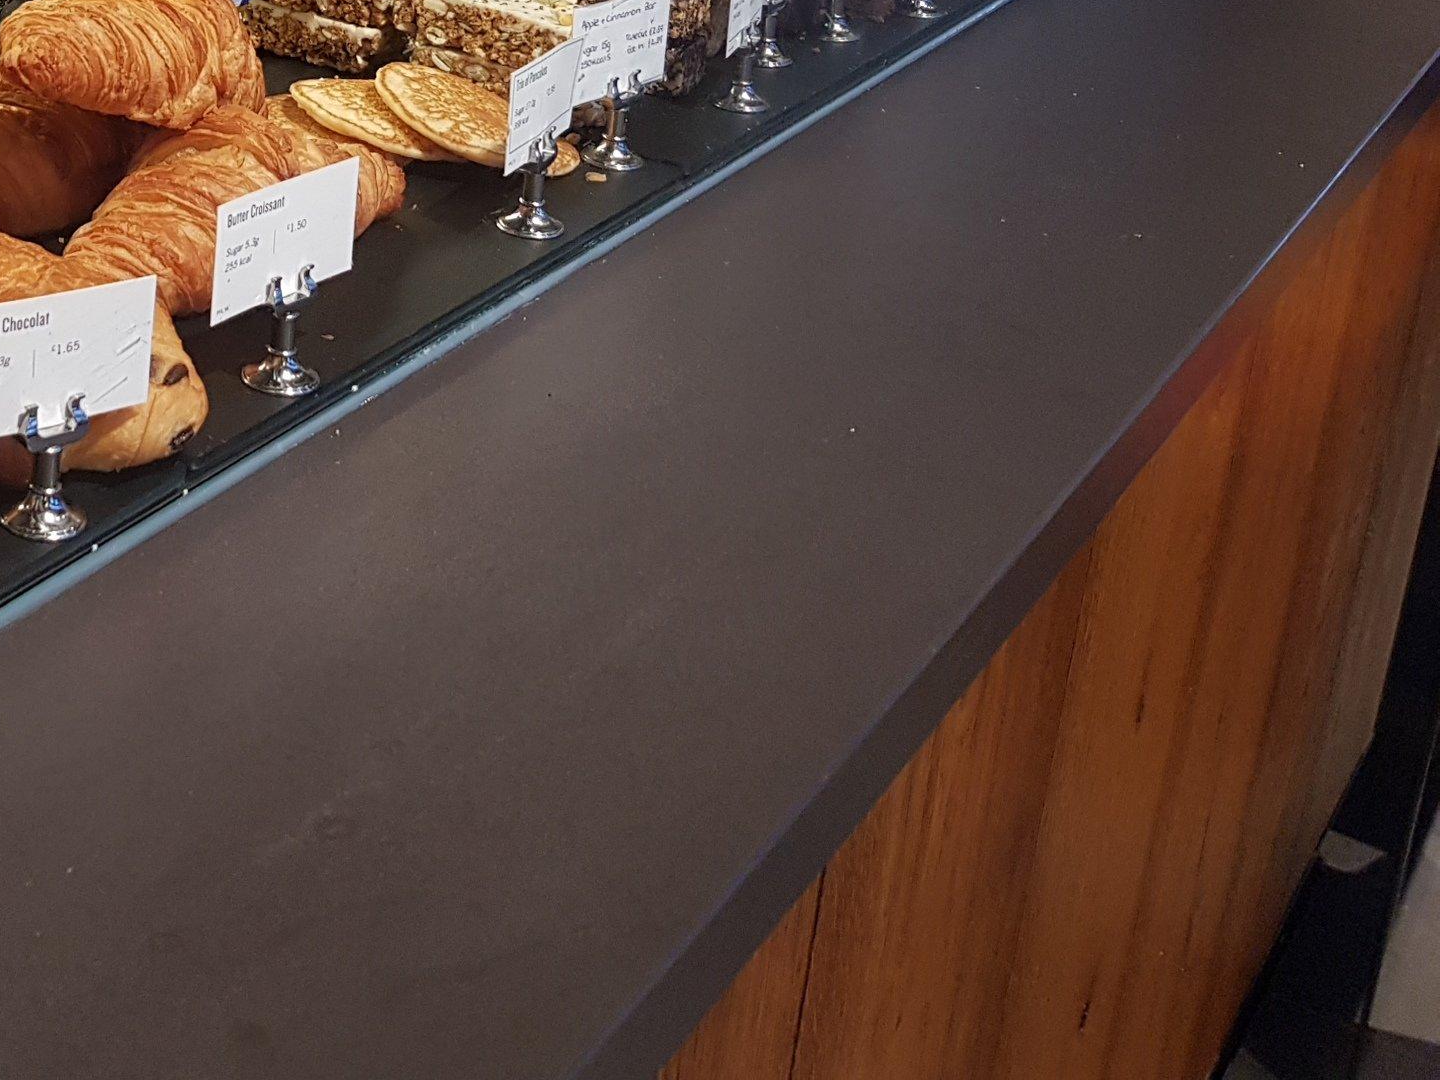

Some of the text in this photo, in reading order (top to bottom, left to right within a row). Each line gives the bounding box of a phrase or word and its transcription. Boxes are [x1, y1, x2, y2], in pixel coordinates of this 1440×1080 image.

[606, 8, 641, 22] Cinnamon
[644, 1, 656, 11] Bar
[583, 45, 598, 57] ugar
[227, 195, 286, 229] Butter Croissant
[226, 241, 244, 258] Sugar
[239, 254, 252, 266] kcal
[2, 312, 50, 333] Chocolat
